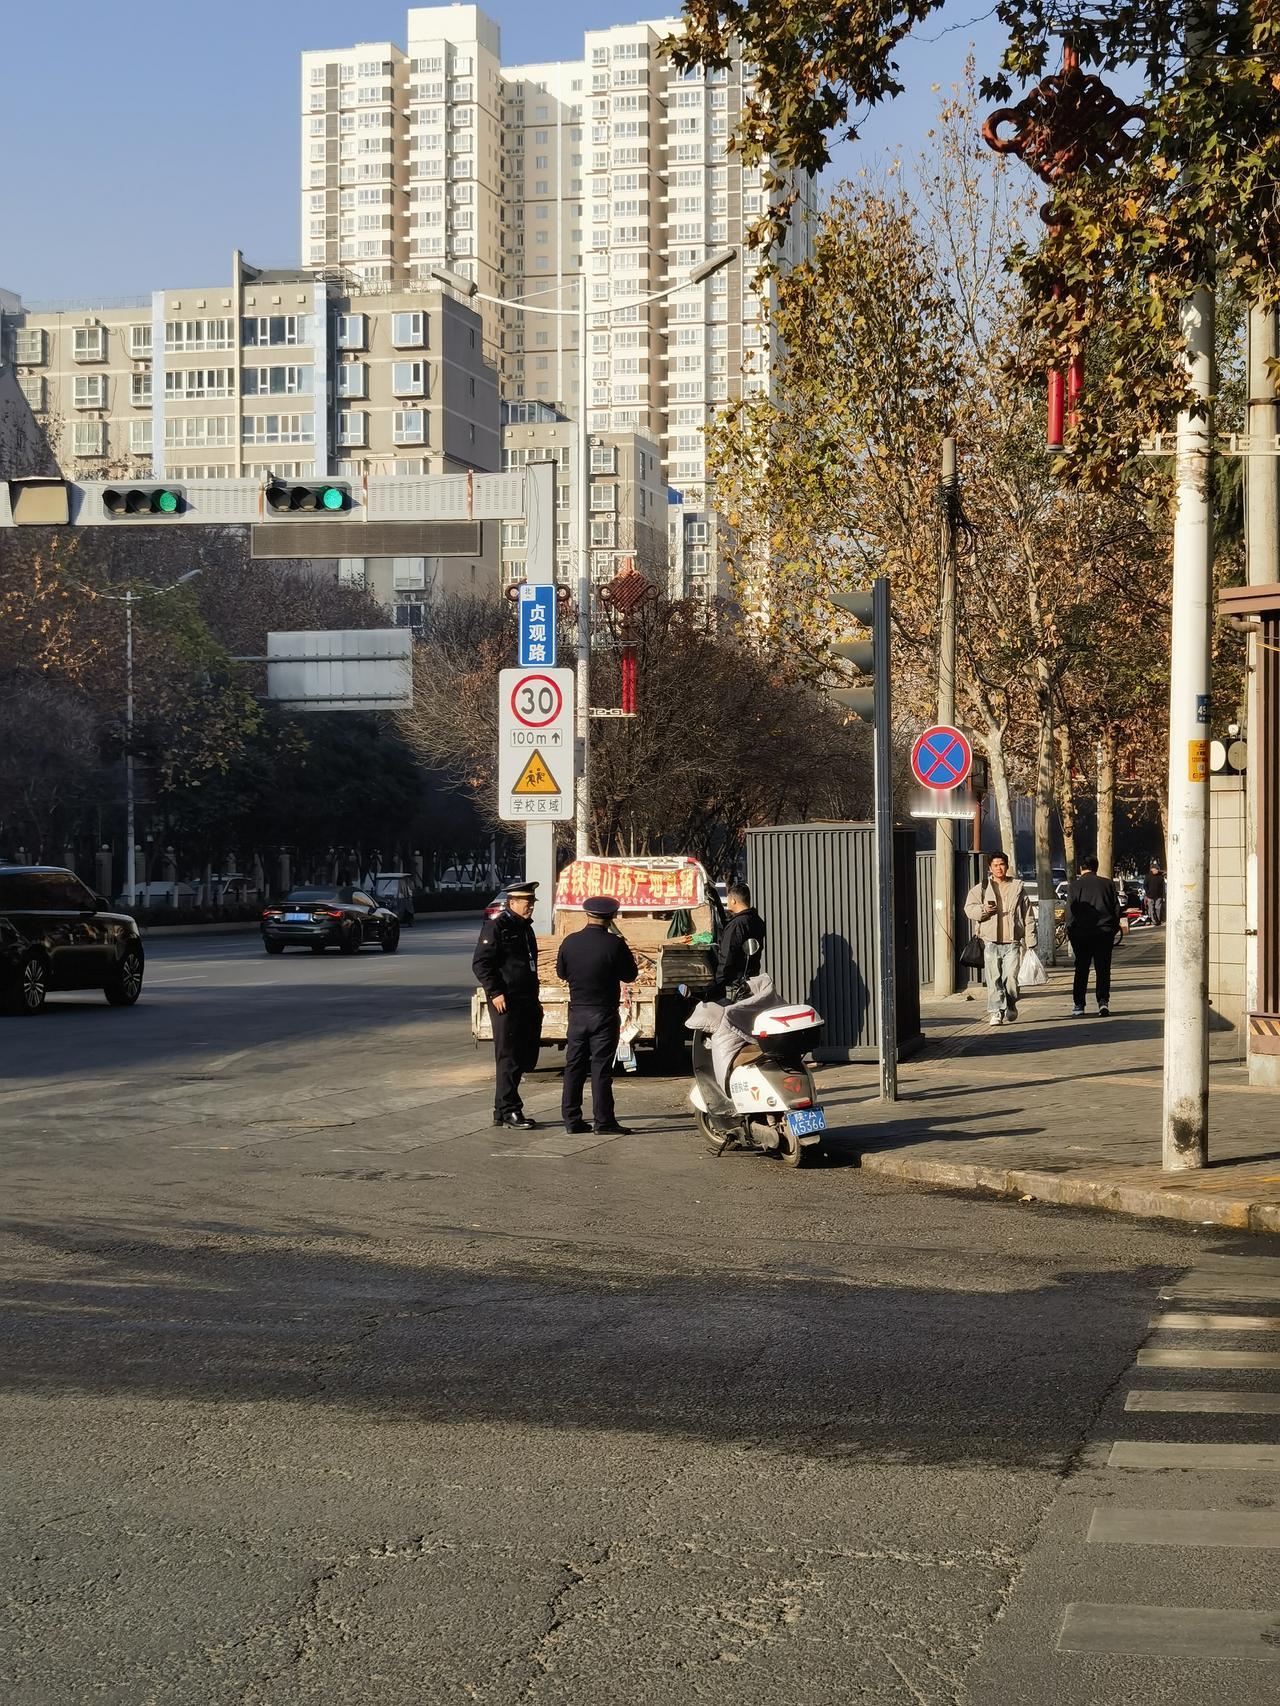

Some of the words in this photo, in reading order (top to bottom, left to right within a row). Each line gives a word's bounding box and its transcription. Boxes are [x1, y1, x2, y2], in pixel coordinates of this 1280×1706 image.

[528, 603, 547, 662] 贞观路
[520, 686, 554, 715] 30
[512, 731, 547, 745] 100m
[512, 798, 560, 813] 学校区域
[792, 1117, 825, 1135] K5366
